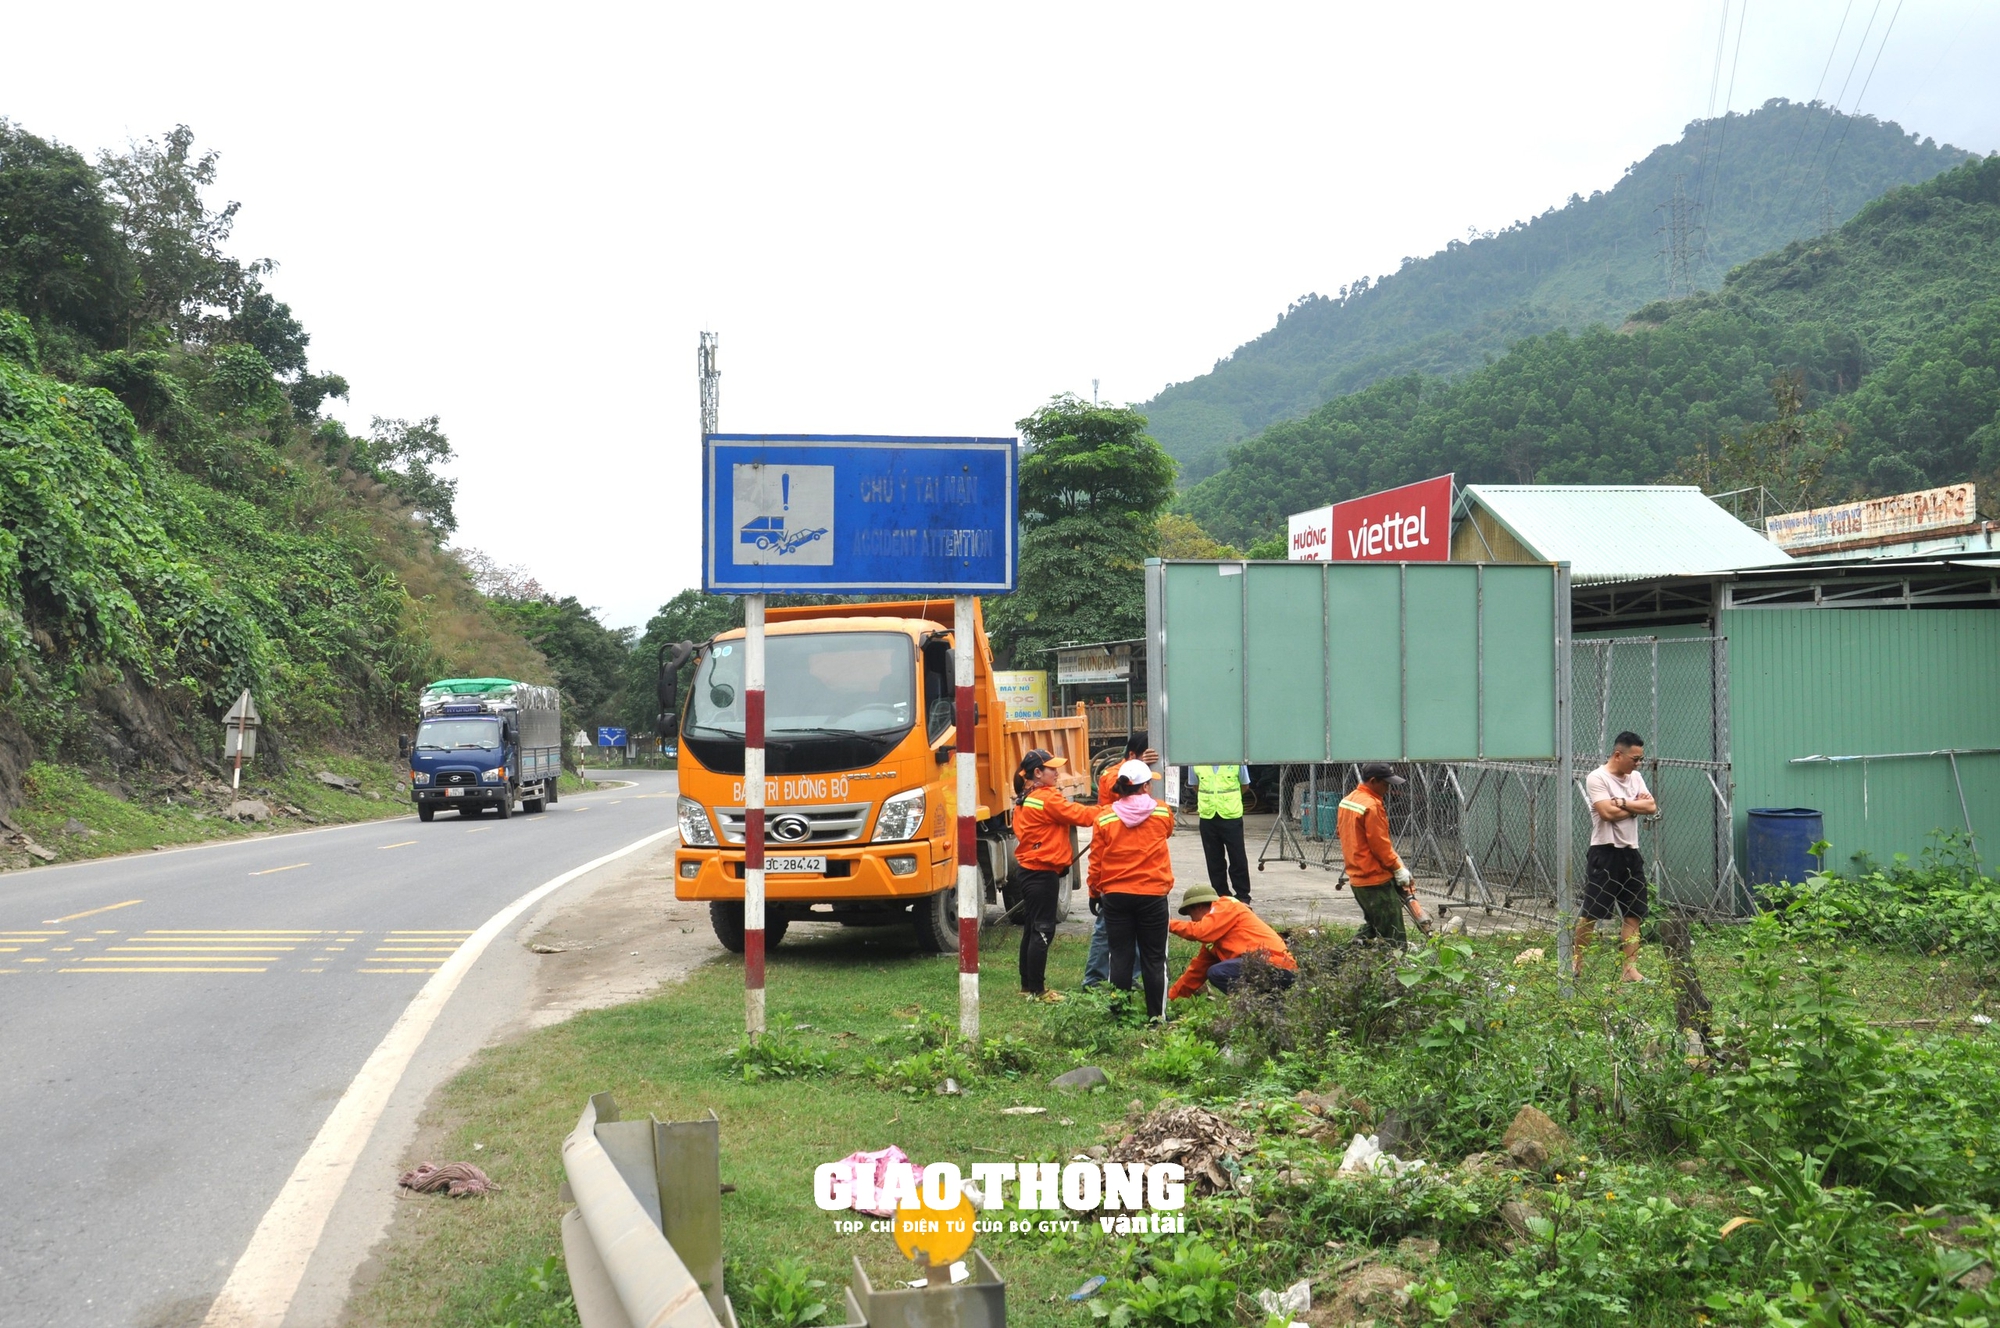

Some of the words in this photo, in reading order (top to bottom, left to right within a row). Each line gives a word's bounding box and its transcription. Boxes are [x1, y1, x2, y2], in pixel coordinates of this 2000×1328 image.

[853, 529, 917, 557] ACCIDENT
[921, 529, 993, 558] ATTENTION
[1293, 524, 1327, 551] HƯỜNG
[784, 775, 827, 800] ĐƯỜNG
[831, 774, 849, 802] BỘ
[847, 771, 896, 781] FORLAND
[766, 858, 820, 871] 3C-284.42
